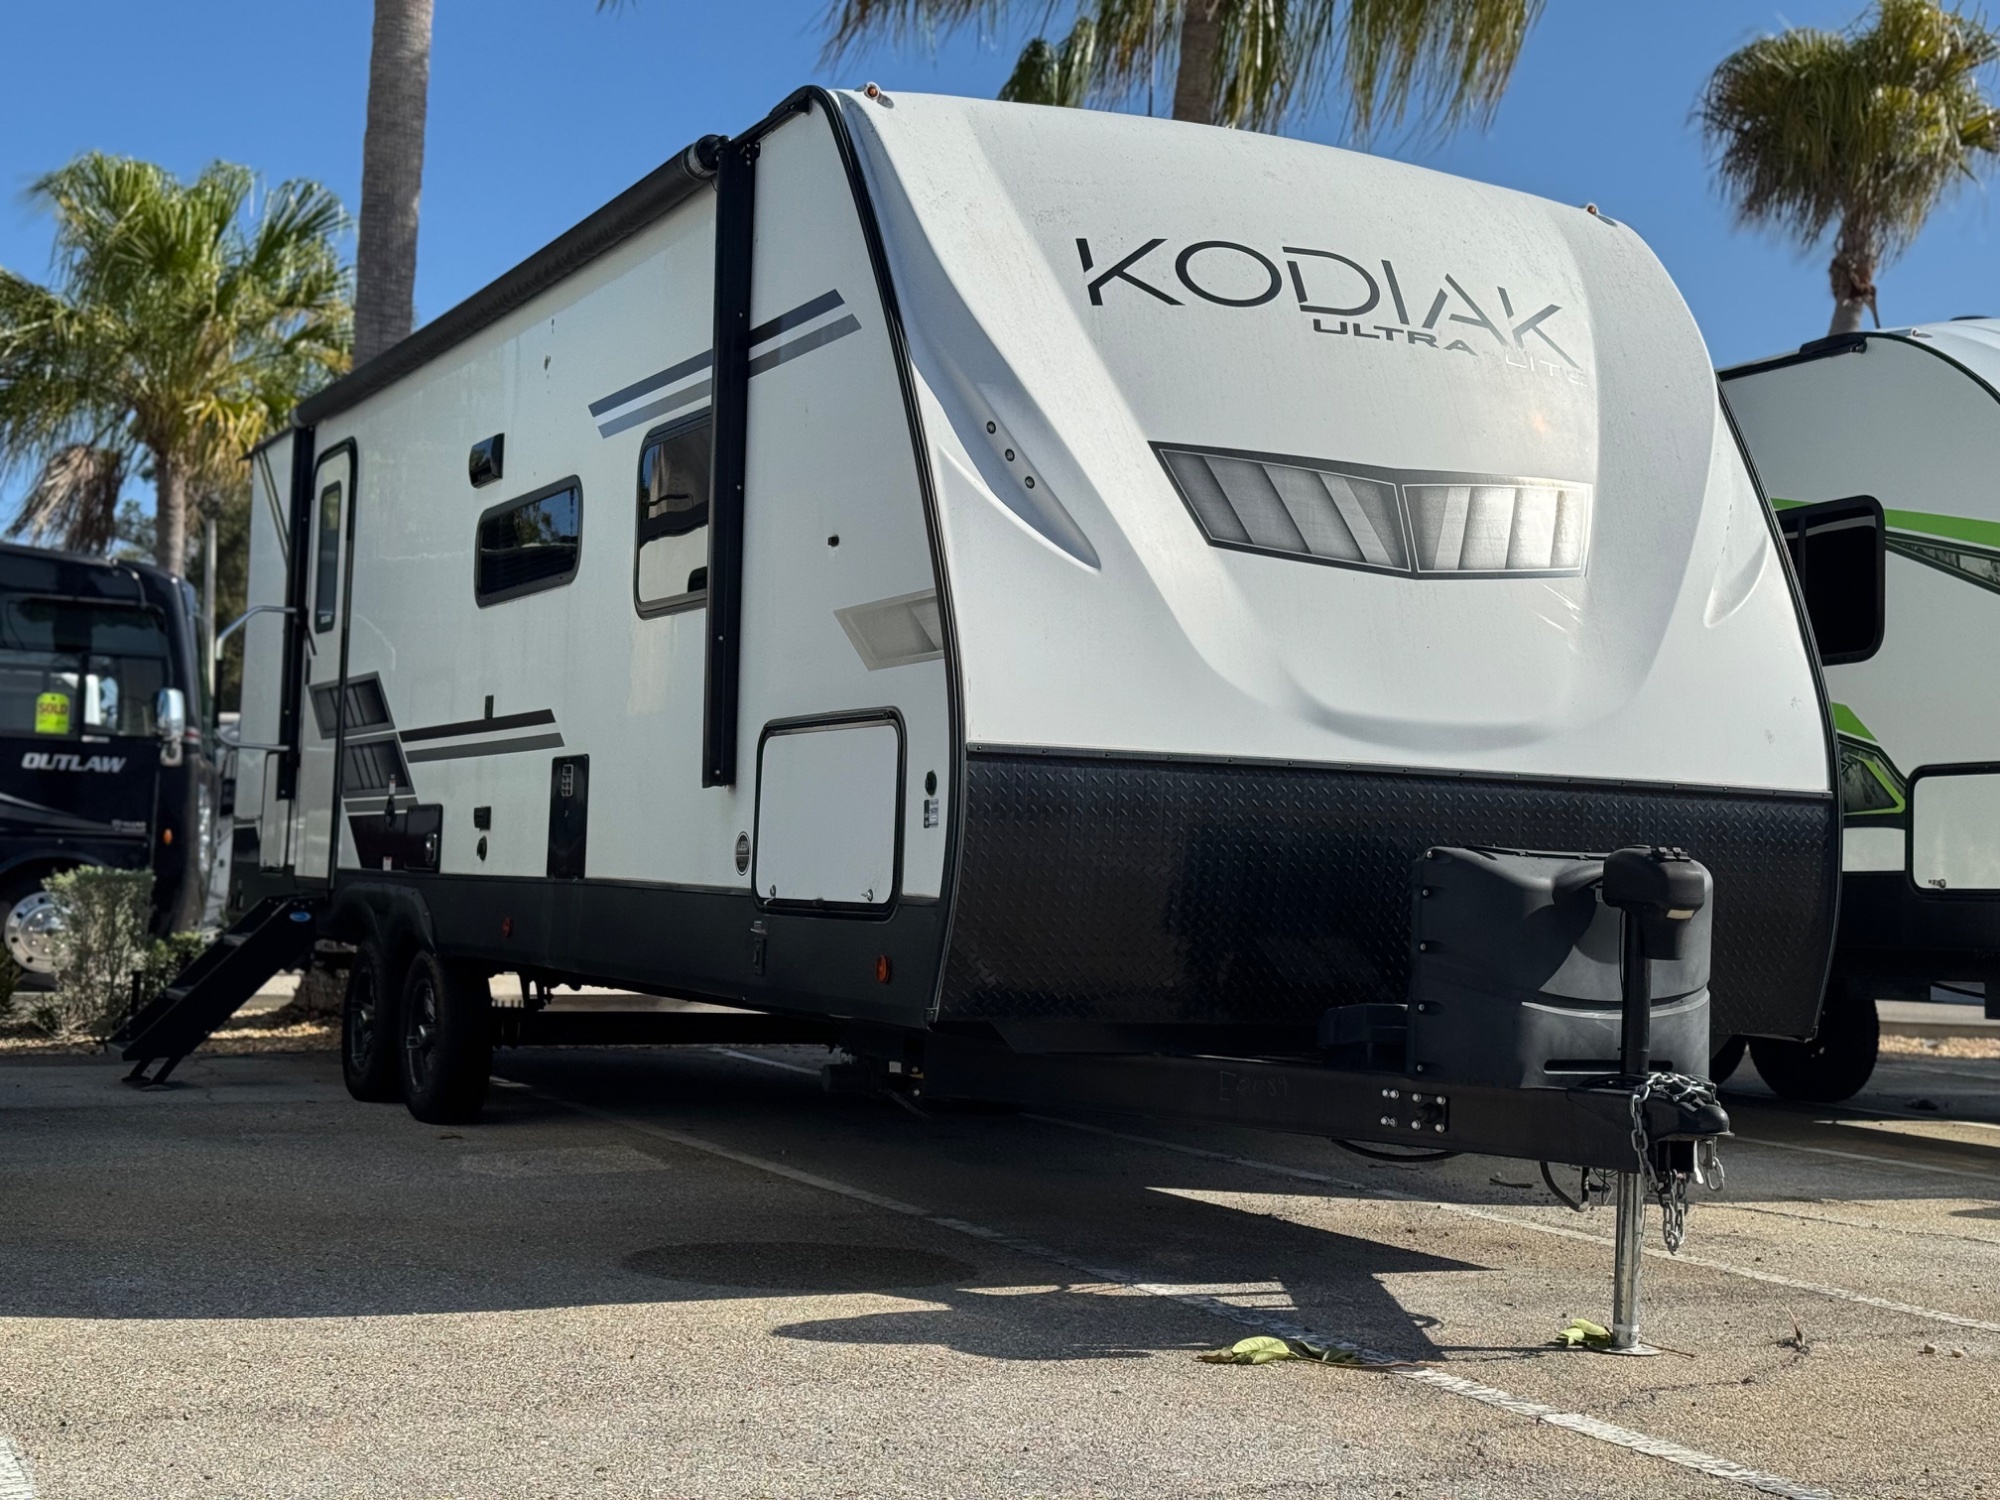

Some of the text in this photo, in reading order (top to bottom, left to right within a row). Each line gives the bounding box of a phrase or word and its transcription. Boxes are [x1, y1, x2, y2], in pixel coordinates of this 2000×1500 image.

[1075, 237, 1583, 369] KODIAK
[1312, 318, 1479, 357] ULTRA
[37, 702, 69, 716] SOLD
[21, 751, 127, 774] OUTLAW
